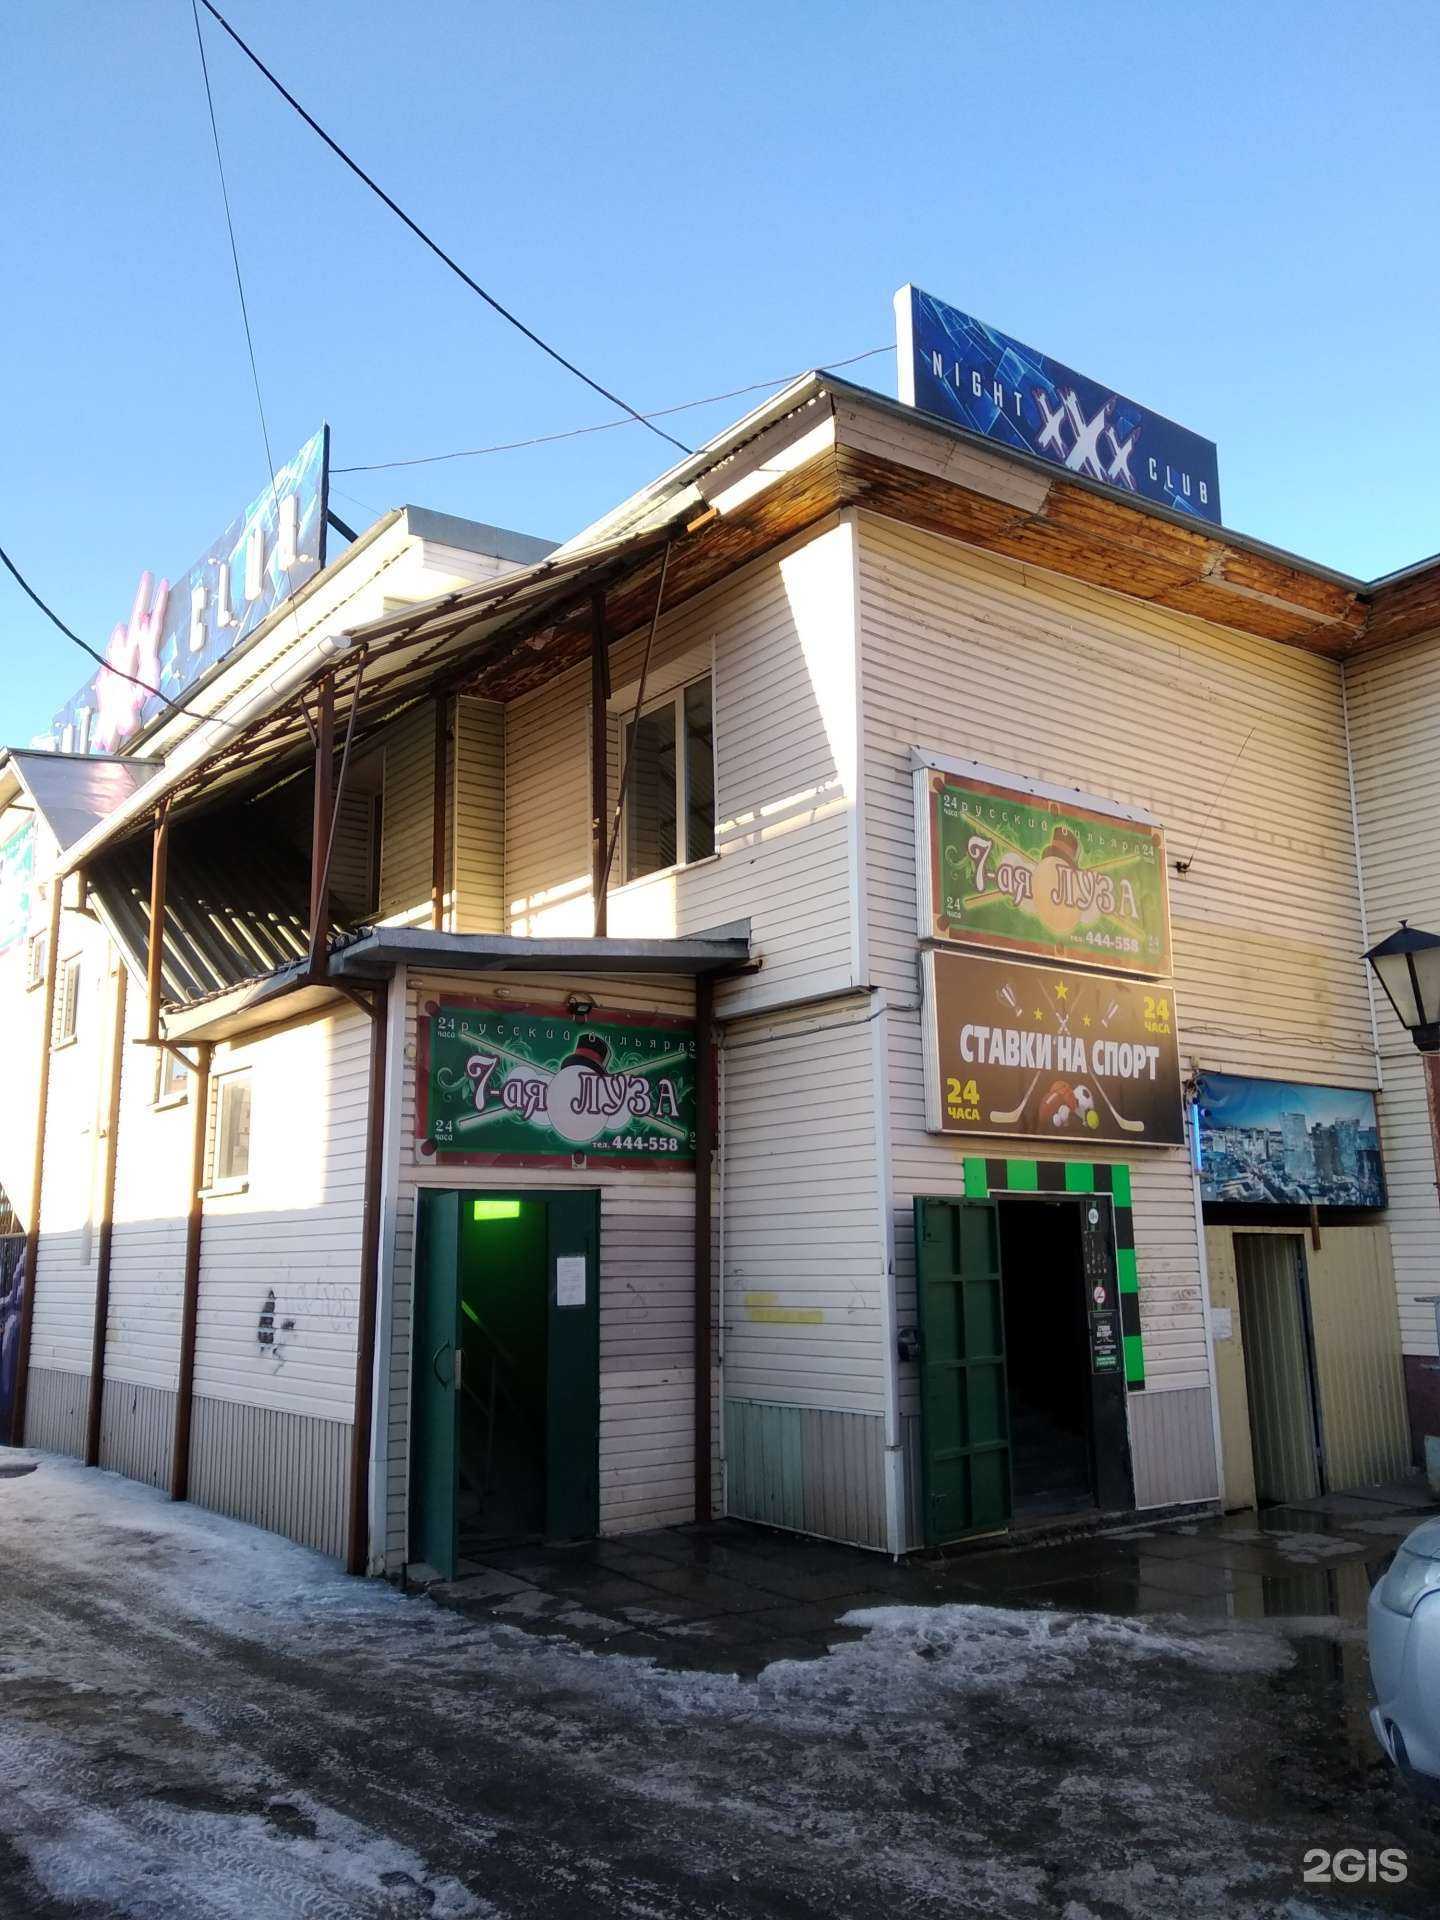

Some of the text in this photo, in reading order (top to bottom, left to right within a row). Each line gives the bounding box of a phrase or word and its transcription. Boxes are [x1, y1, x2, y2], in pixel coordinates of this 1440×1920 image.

[932, 350, 1023, 417] NIGHT
[1148, 457, 1208, 504] CLUB
[943, 794, 958, 809] 24
[1142, 844, 1154, 857] 24
[968, 836, 1139, 920] 7-ая ЛУЗА
[946, 895, 960, 910] 24
[1085, 930, 1139, 952] 444-558
[1144, 996, 1170, 1020] 24
[438, 1016, 454, 1029] 24
[461, 1021, 570, 1040] русский
[1144, 1022, 1171, 1034] ЧАСА
[960, 1024, 1160, 1080] СТАВКИ НА СПОРТ
[467, 1055, 680, 1119] 7-ая ЛУЗА
[946, 1077, 980, 1105] 24
[947, 1107, 981, 1120] ЧАСА
[435, 1119, 453, 1132] 24
[612, 1135, 678, 1151] 444-558
